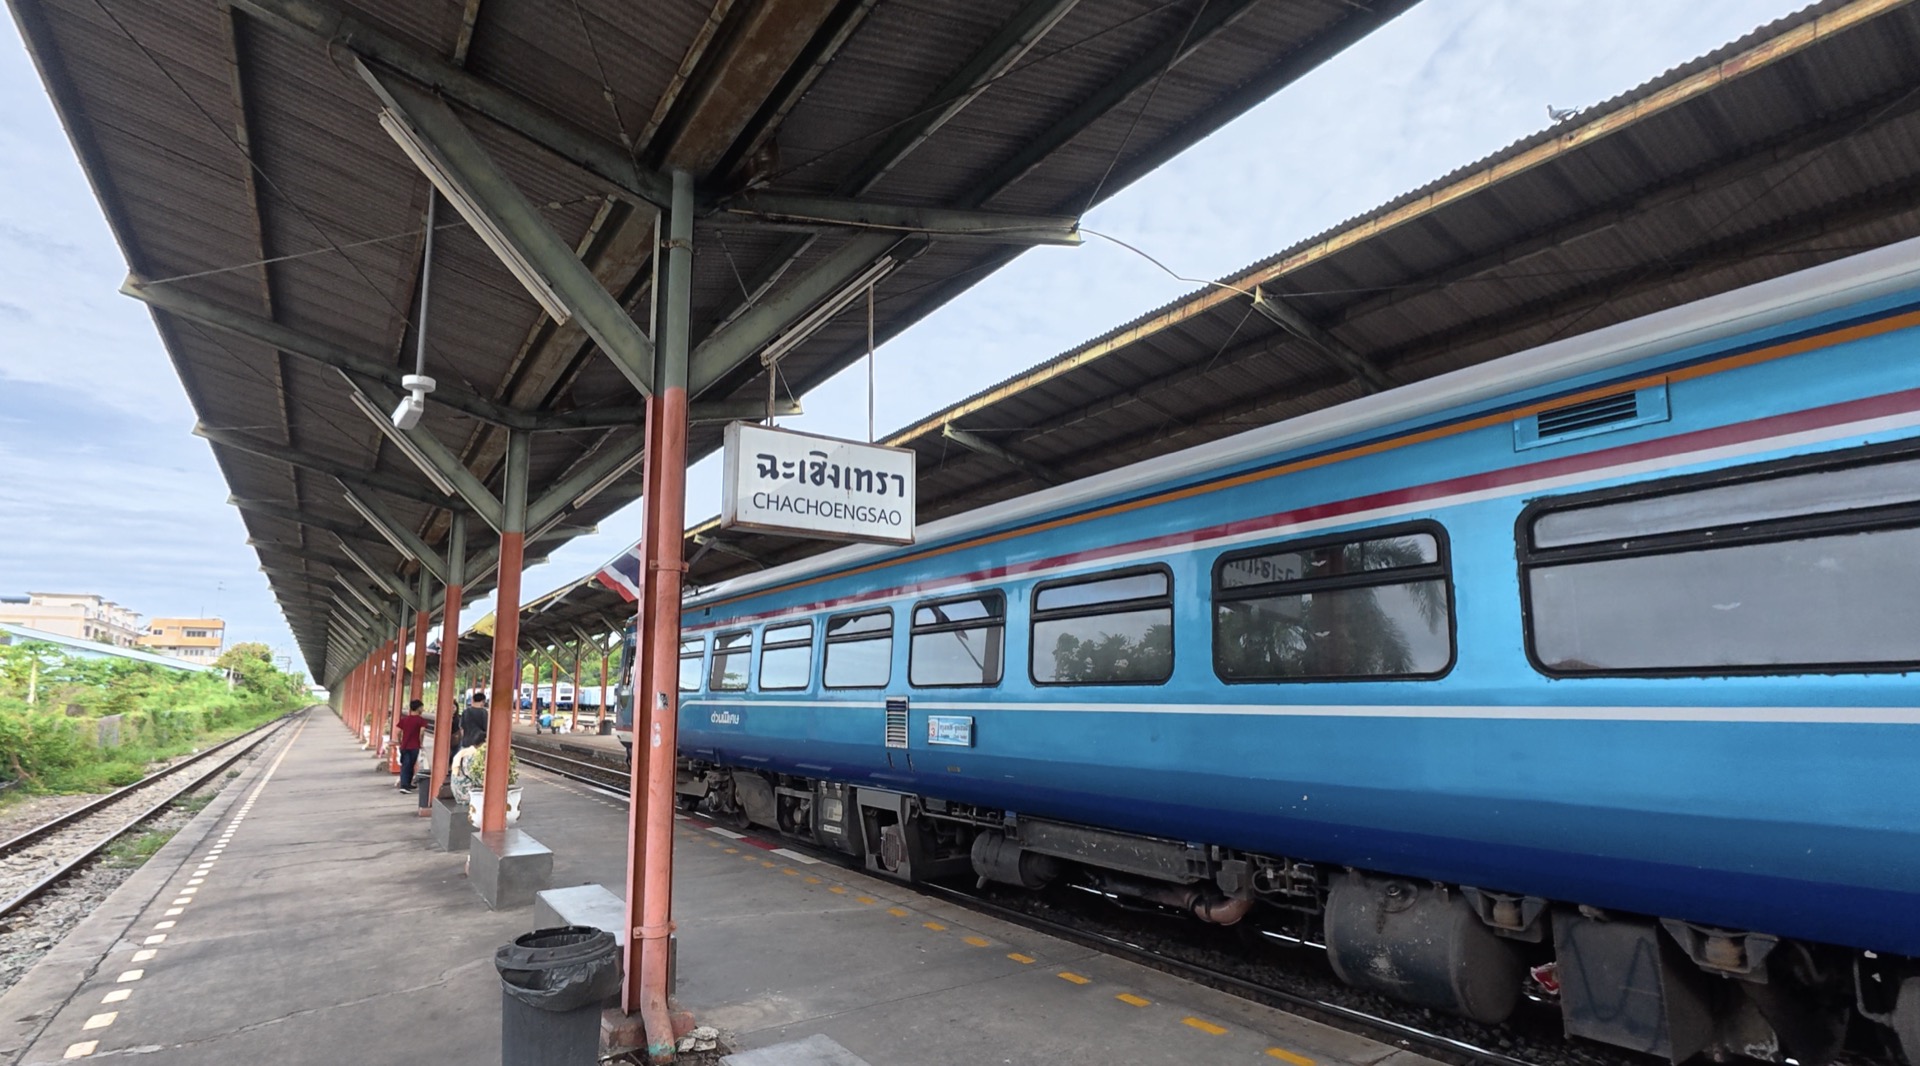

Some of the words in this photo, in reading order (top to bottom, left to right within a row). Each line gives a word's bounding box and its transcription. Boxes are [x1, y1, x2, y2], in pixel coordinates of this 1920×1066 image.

[756, 450, 905, 498] ฉะเชิงเทรา
[753, 492, 902, 526] CHACHOENGSAO
